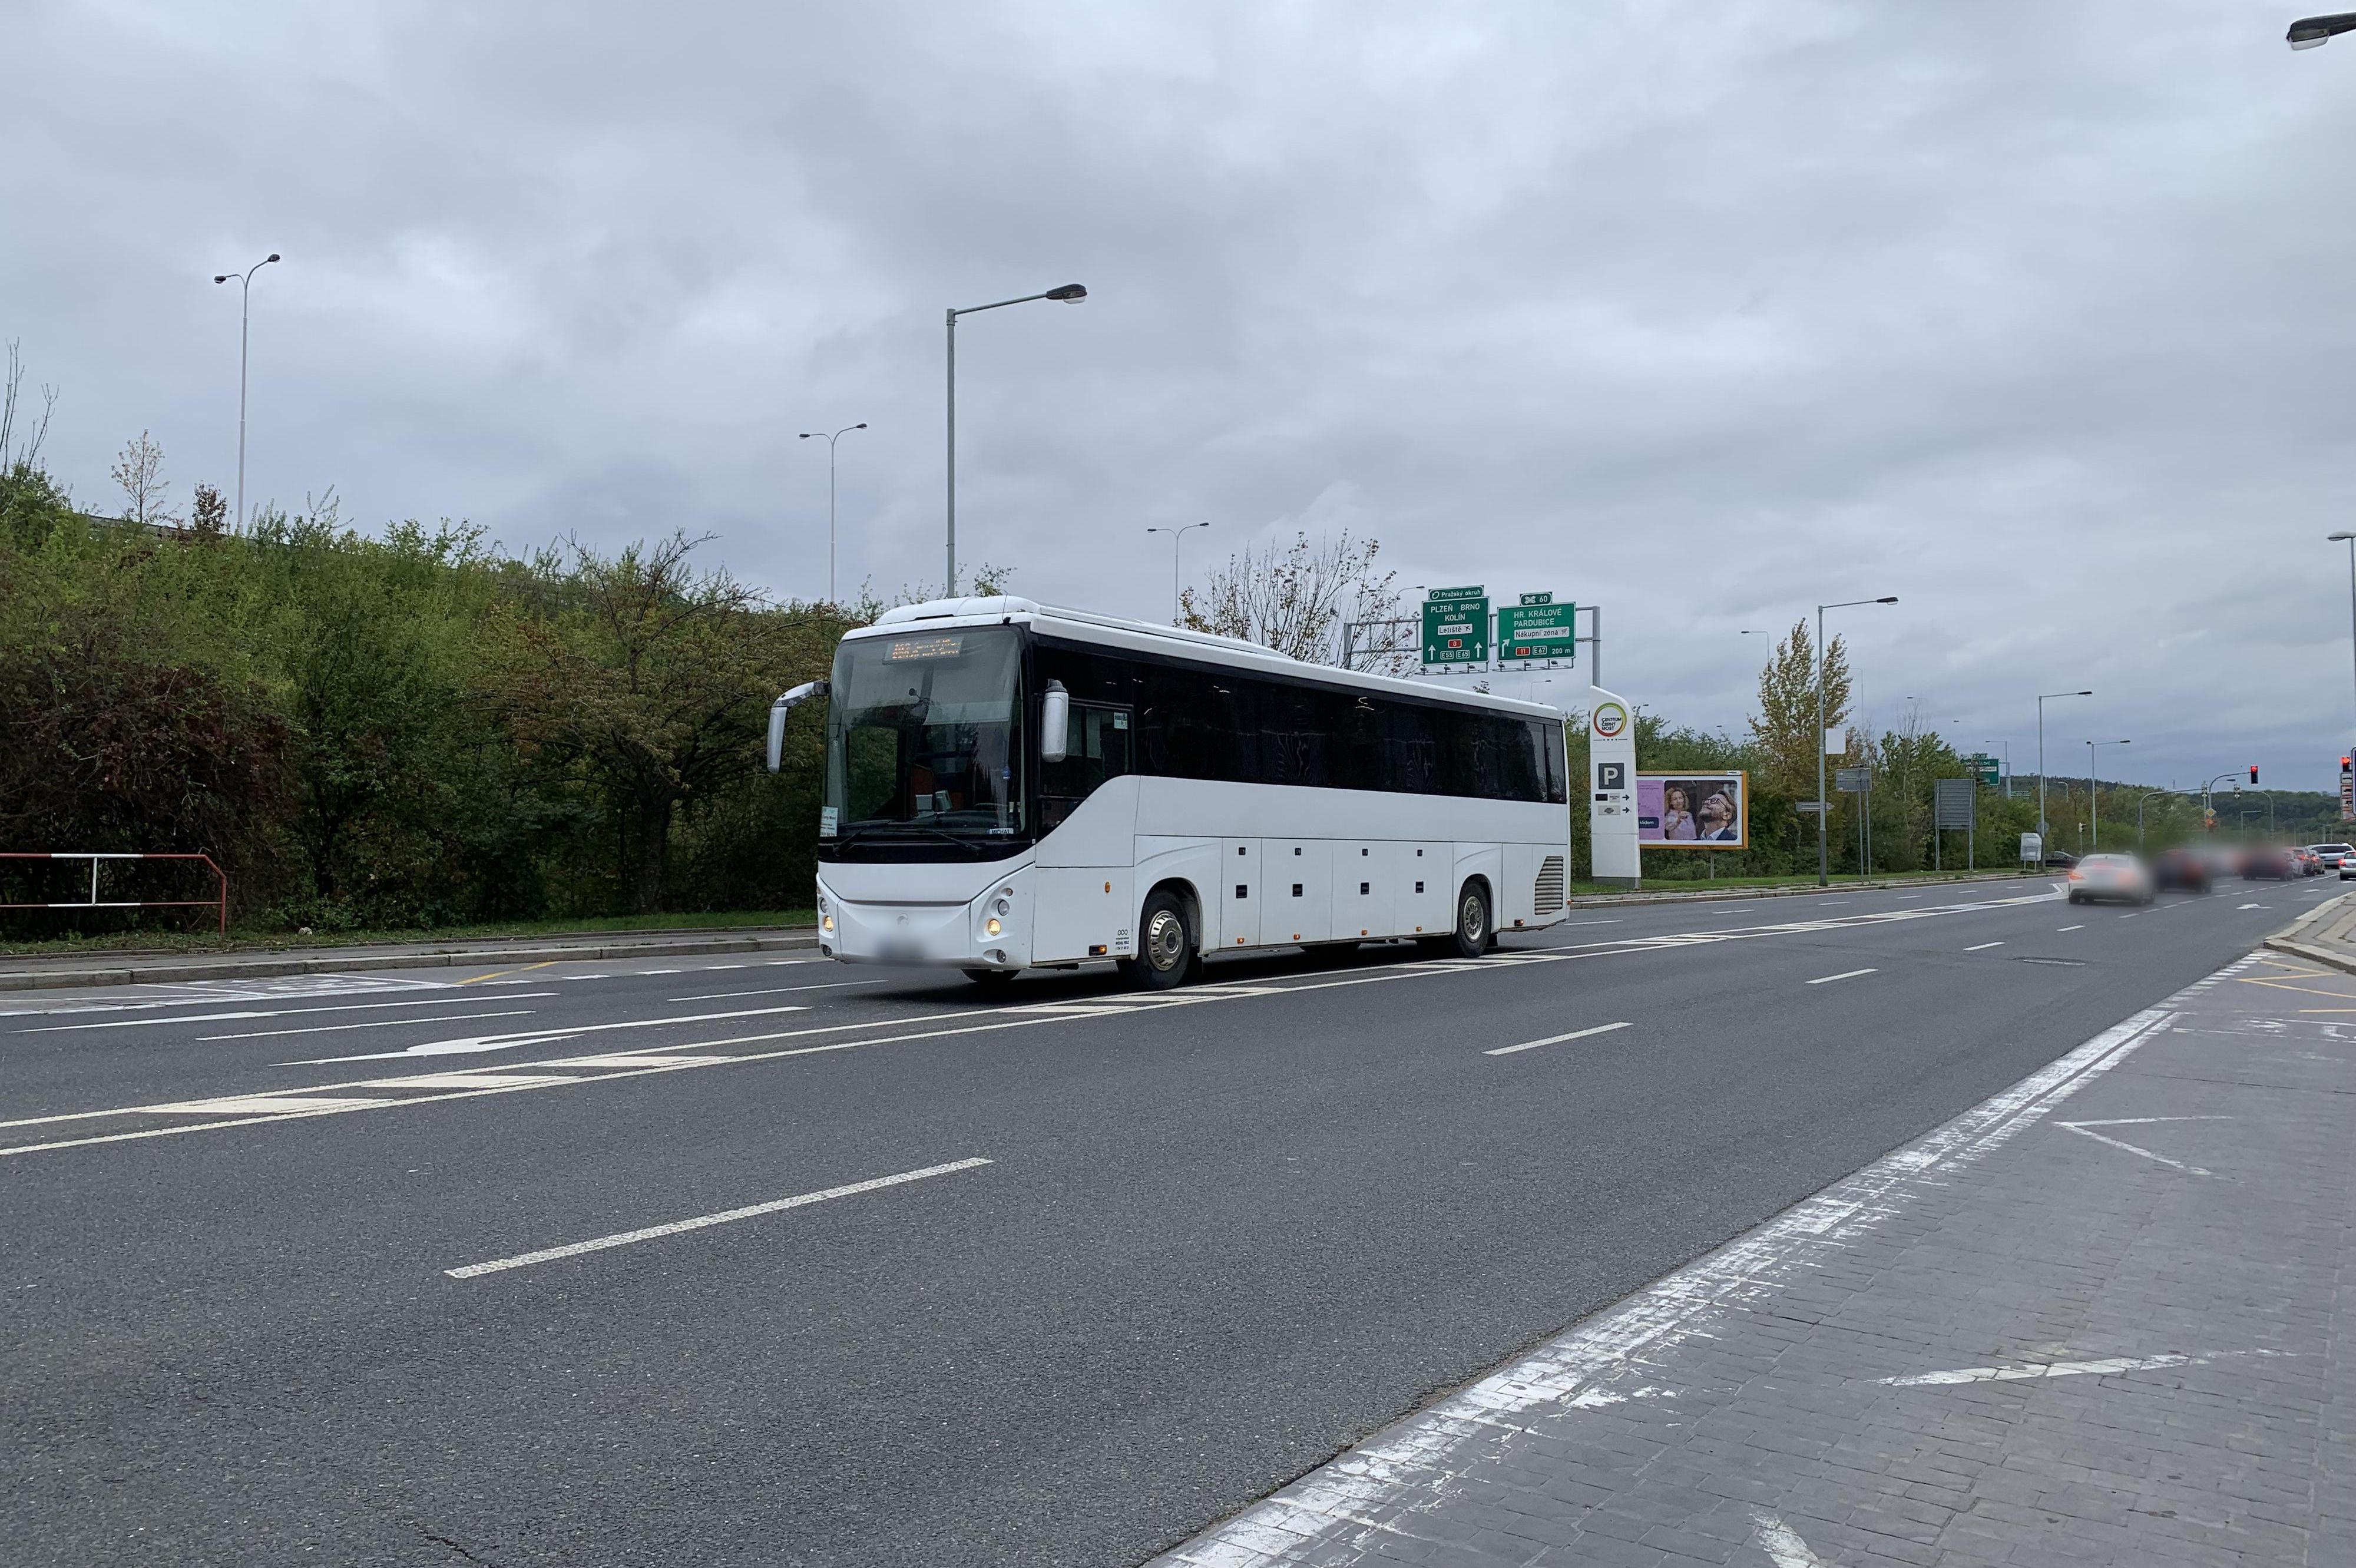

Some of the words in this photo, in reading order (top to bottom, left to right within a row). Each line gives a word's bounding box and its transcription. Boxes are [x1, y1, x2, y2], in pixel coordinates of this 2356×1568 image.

[1431, 604, 1453, 613] PLZEŇ
[1528, 607, 1562, 617] KRÁLOVÉ
[1445, 613, 1465, 621] KOLÍN
[1514, 618, 1554, 627] PARDUBICE
[1604, 768, 1618, 785] P
